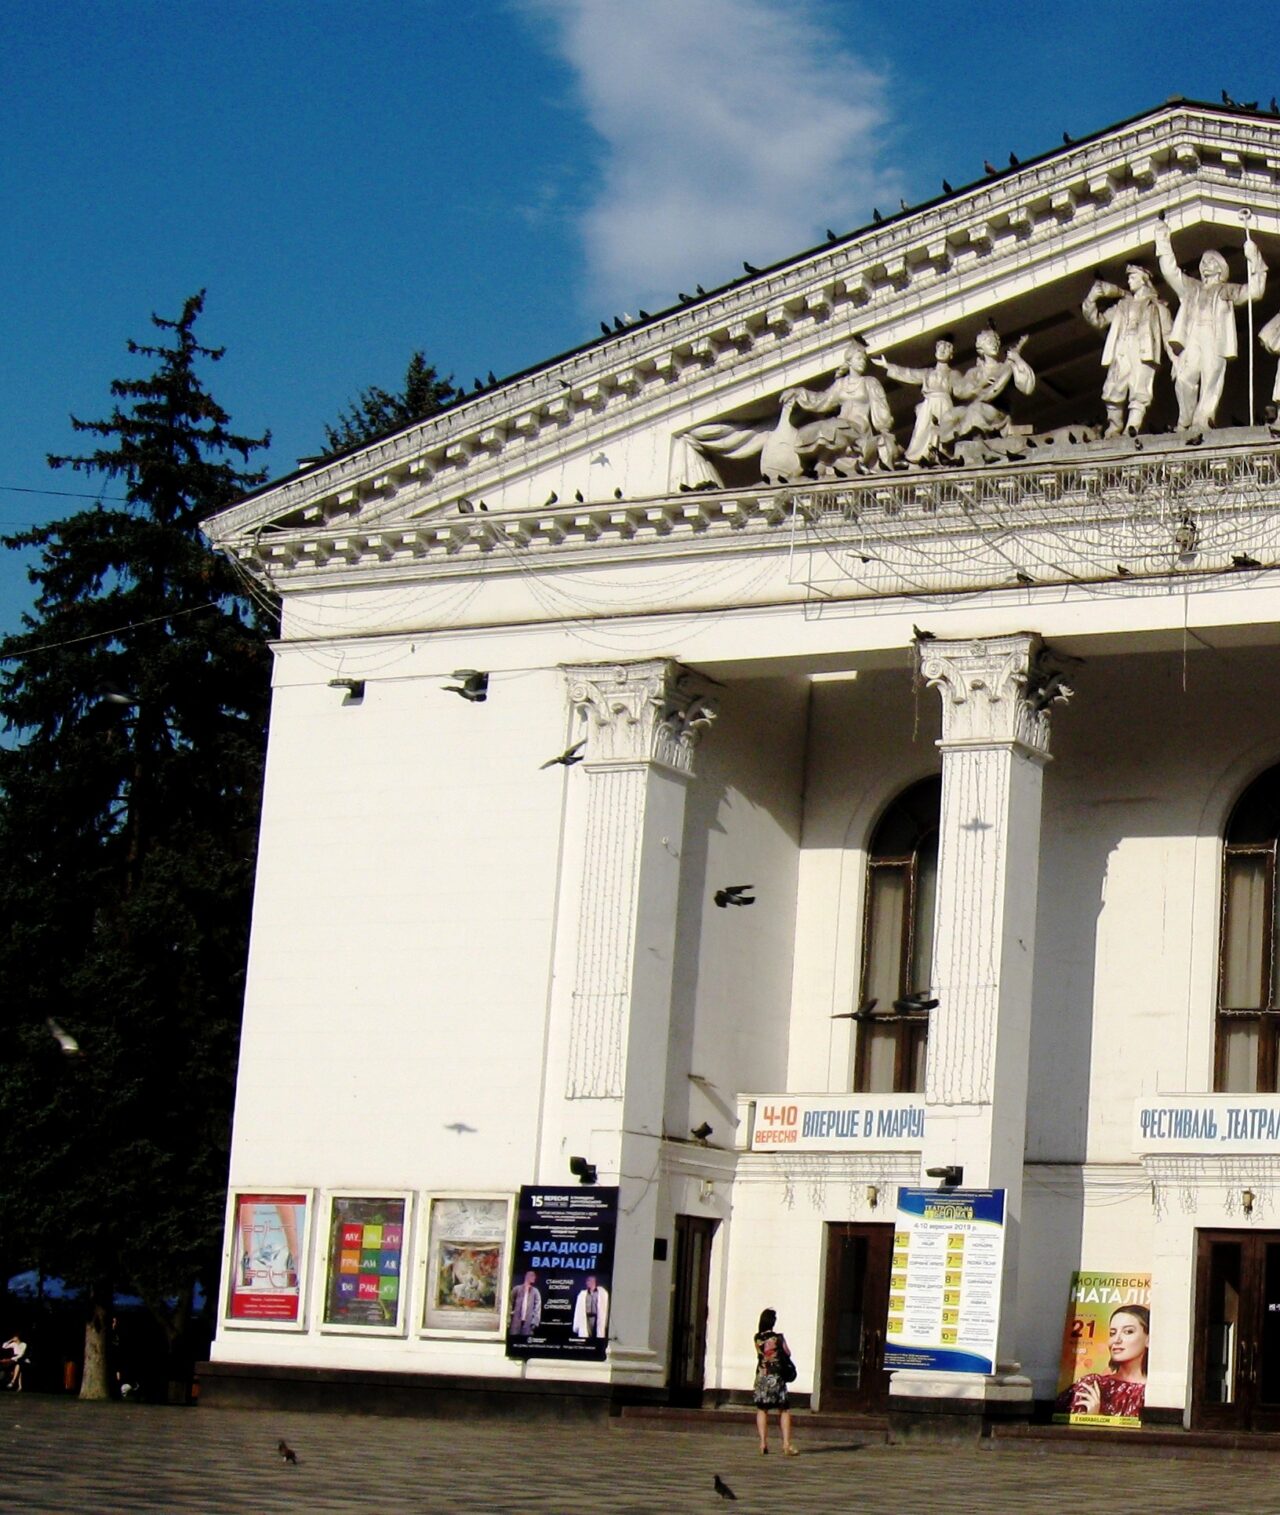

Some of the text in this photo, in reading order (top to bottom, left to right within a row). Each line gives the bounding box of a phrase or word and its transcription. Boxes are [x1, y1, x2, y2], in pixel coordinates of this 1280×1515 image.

[763, 1106, 798, 1126] 4-10
[802, 1110, 860, 1138] ВПЕРШЕ
[863, 1110, 873, 1138] В
[1140, 1108, 1218, 1138] ФЕСТИВАЛЬ
[755, 1129, 797, 1143] ВЕРЕСНЯ
[531, 1195, 543, 1207] 15
[523, 1240, 603, 1254] ЗАГАДКОВІ
[531, 1256, 597, 1271] ВАРІАЦІЇ
[1071, 1320, 1096, 1338] 21
